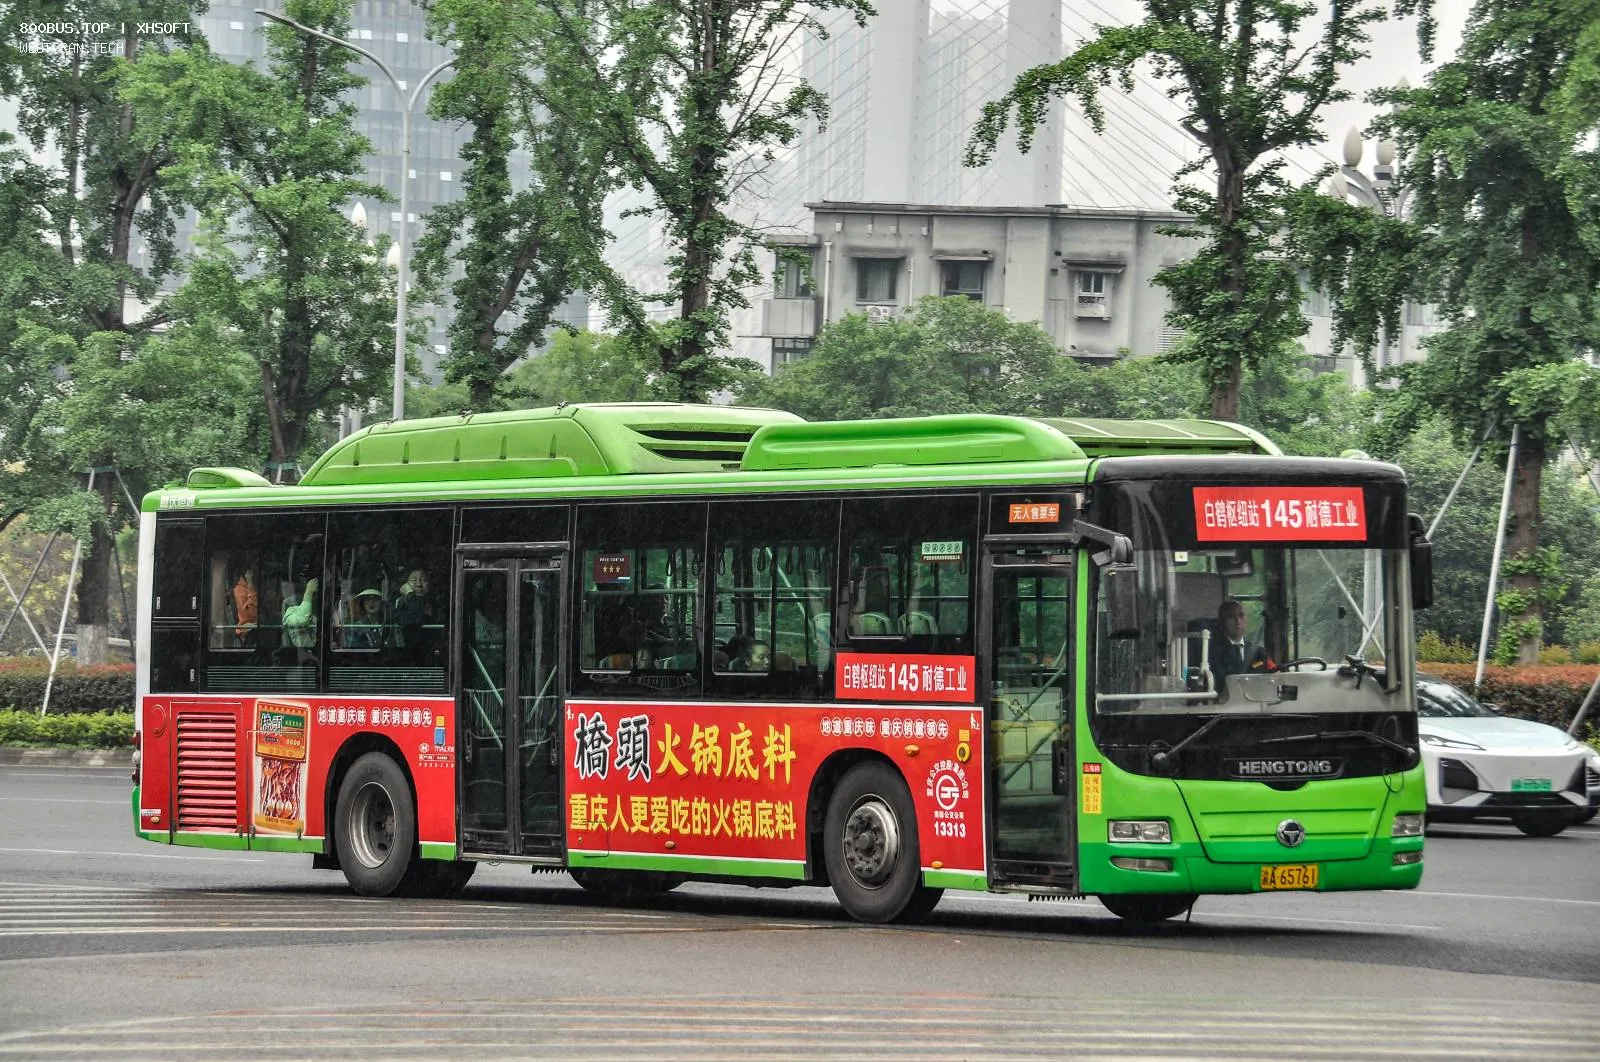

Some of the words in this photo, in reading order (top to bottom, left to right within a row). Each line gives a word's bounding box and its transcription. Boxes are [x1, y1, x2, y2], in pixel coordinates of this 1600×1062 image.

[1013, 506, 1057, 520] 无人售票车
[1204, 501, 1260, 528] 白鹤枢纽站
[1261, 499, 1303, 528] 145
[1304, 500, 1359, 528] 耐德工业
[843, 662, 887, 689] 白鹤枢纽站
[888, 663, 920, 692] 145
[922, 665, 968, 691] 耐德工业
[820, 716, 876, 738] 地道重庆味
[880, 717, 949, 740] 重庆销量领先
[655, 722, 797, 785] 火锅底料
[1239, 760, 1332, 775] HENGTONG
[569, 793, 797, 840] 重庆人更爱吃的火锅底料
[934, 821, 966, 838] 13313
